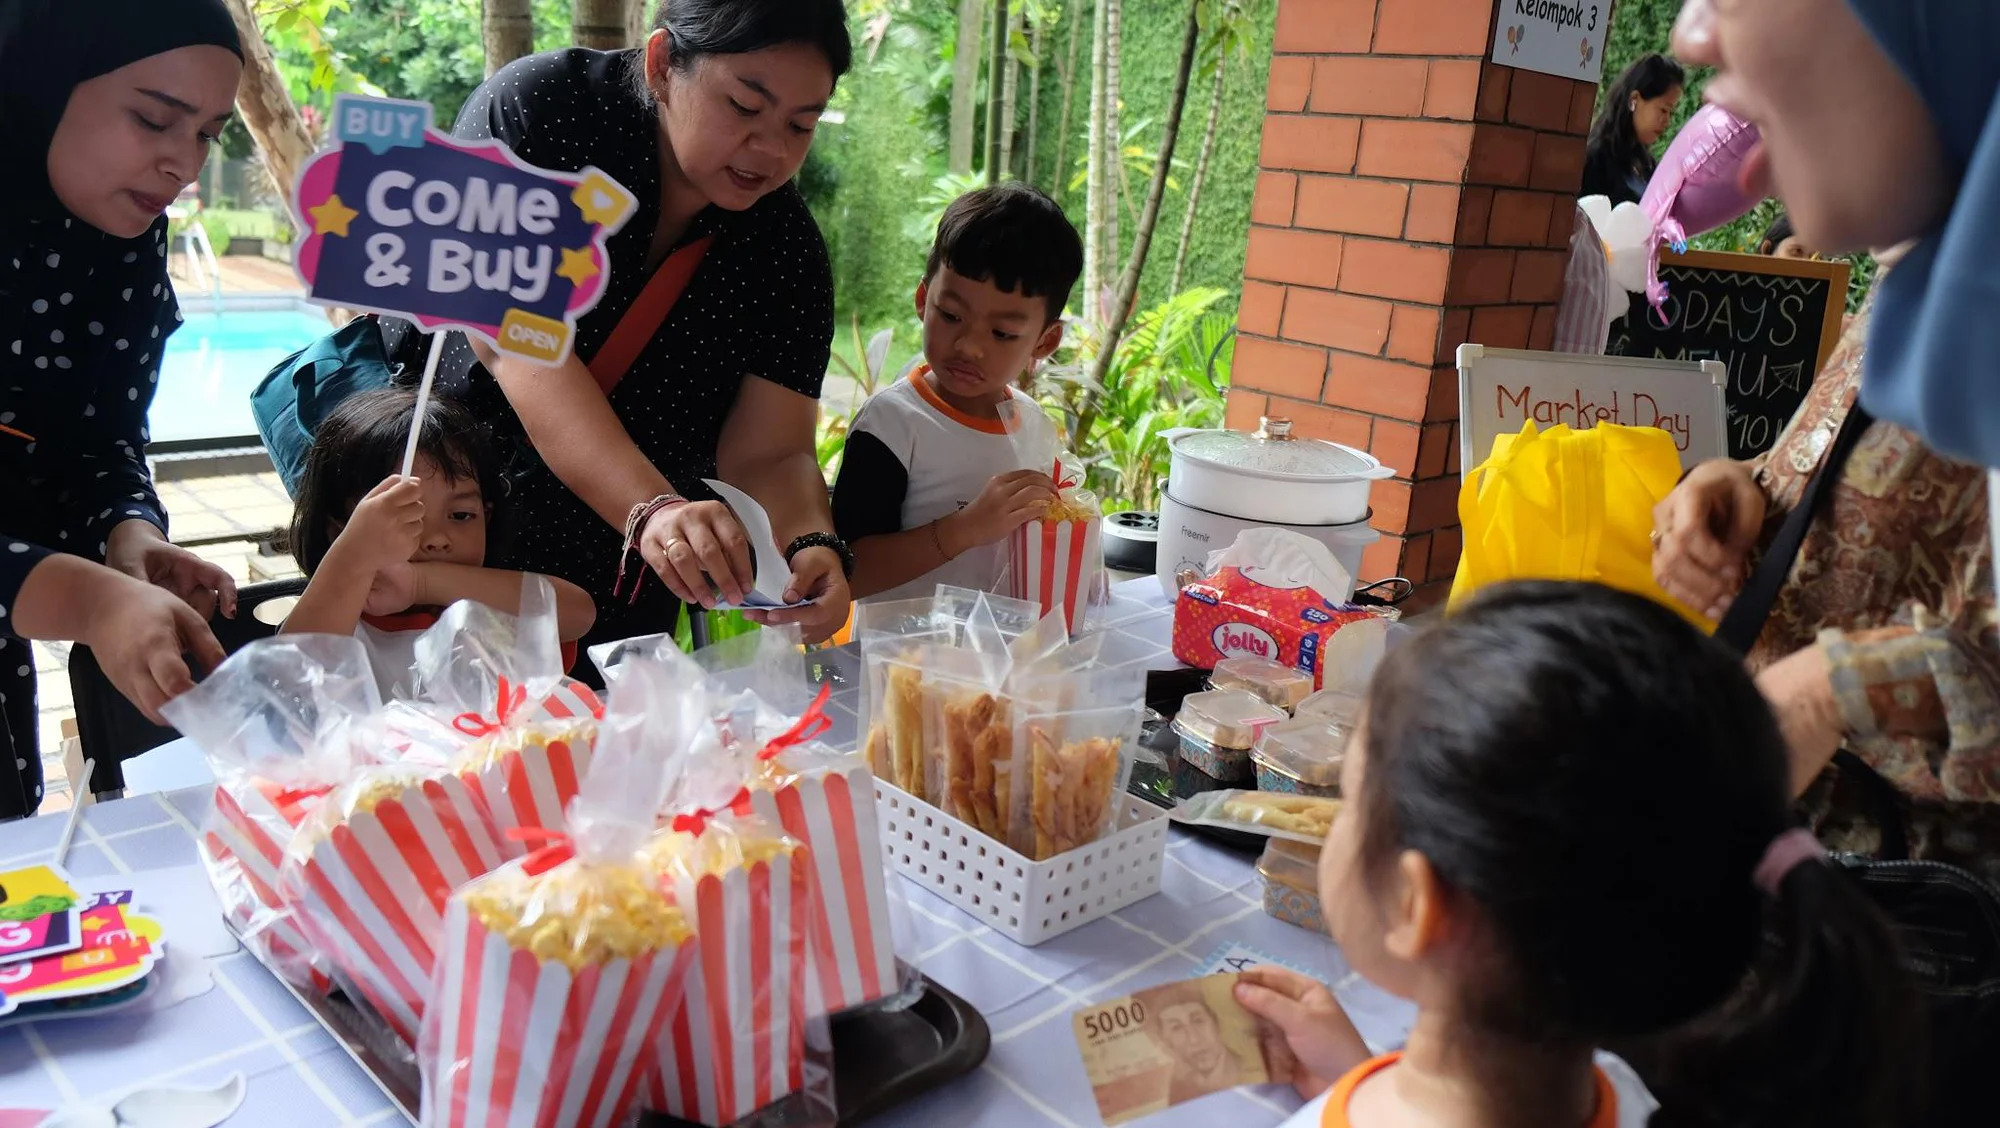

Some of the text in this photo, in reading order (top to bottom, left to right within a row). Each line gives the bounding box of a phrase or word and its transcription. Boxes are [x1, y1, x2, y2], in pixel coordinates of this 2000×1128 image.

[1515, 0, 1598, 32] Kelompok 3
[345, 107, 418, 138] BUY
[364, 232, 553, 302] & Buy
[1624, 287, 1804, 346] ODAY'S
[508, 324, 560, 351] OPEN
[1306, 608, 1329, 621] 250
[1221, 625, 1269, 657] jolly
[1084, 1001, 1145, 1039] 5000
